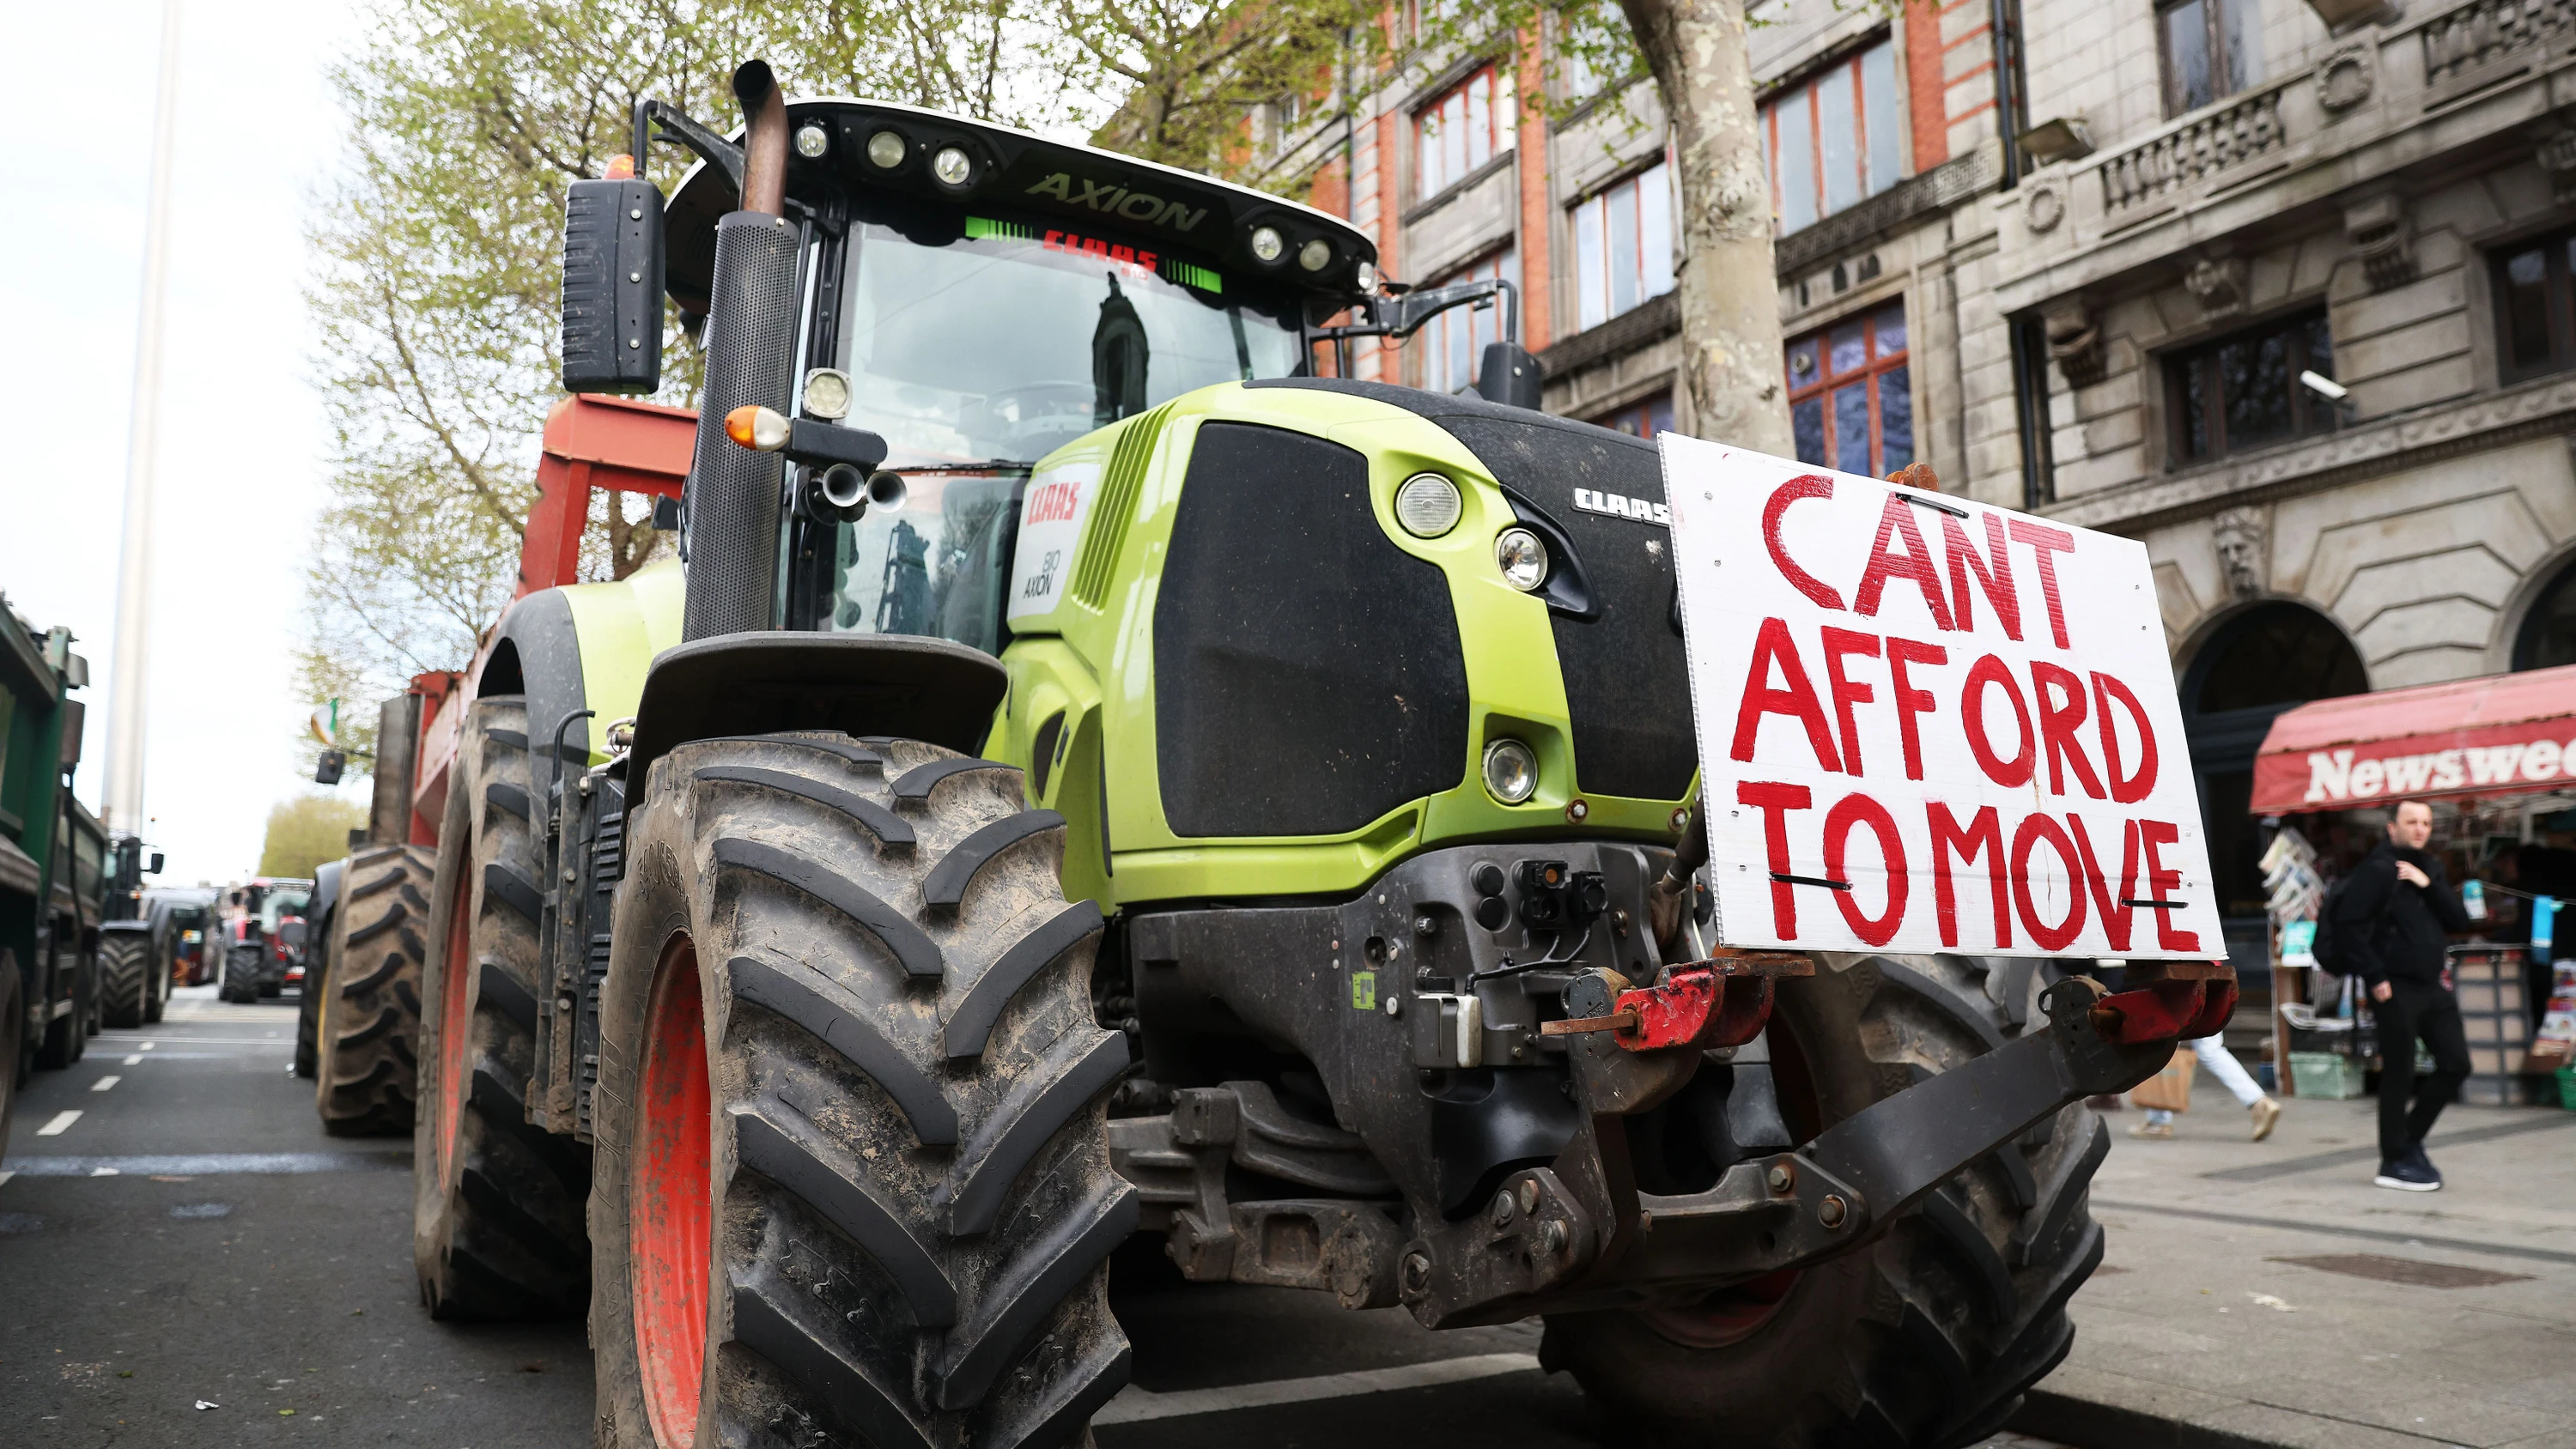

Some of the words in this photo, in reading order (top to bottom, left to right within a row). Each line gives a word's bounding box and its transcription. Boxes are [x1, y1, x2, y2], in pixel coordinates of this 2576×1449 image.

[1024, 173, 1208, 231] AXION
[1043, 229, 1158, 273] CLAAS
[1027, 482, 1081, 526] CLAAS
[1574, 488, 1670, 525] CLAAS
[1024, 573, 1054, 599] AXION
[1762, 474, 2075, 650] CANT
[1730, 616, 2159, 803] AFFORD
[1737, 779, 1908, 948] TO
[1926, 800, 2200, 951] MOVE
